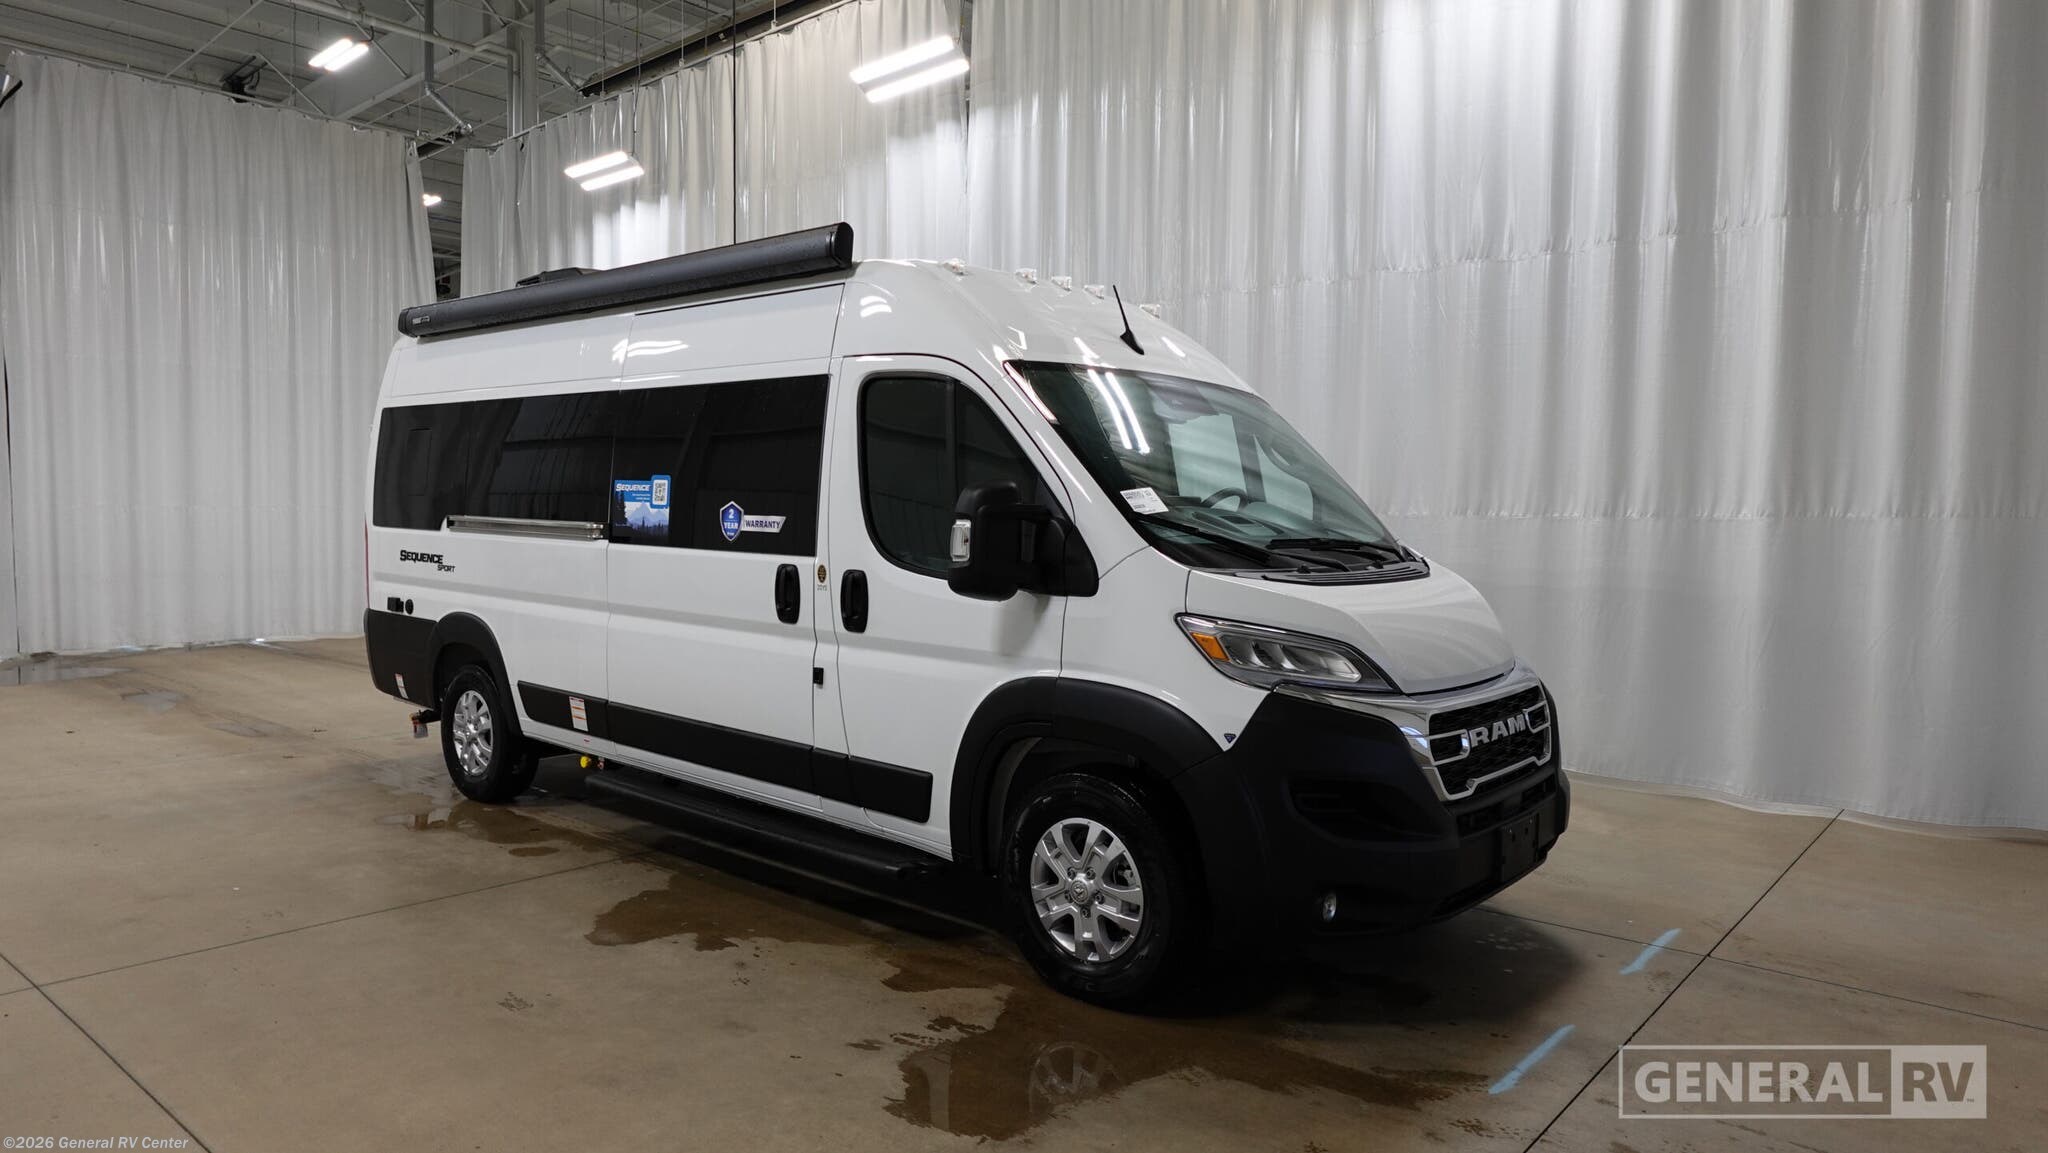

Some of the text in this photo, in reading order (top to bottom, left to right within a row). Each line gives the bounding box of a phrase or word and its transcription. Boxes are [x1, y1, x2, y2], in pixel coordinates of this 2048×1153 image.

[616, 483, 650, 491] SEQUENCE
[728, 508, 735, 519] 2
[723, 521, 739, 530] YEAR
[745, 519, 781, 529] WARRANTY
[400, 549, 444, 564] SEQUENCE
[437, 564, 456, 573] SPORT
[1469, 713, 1526, 748] RAM
